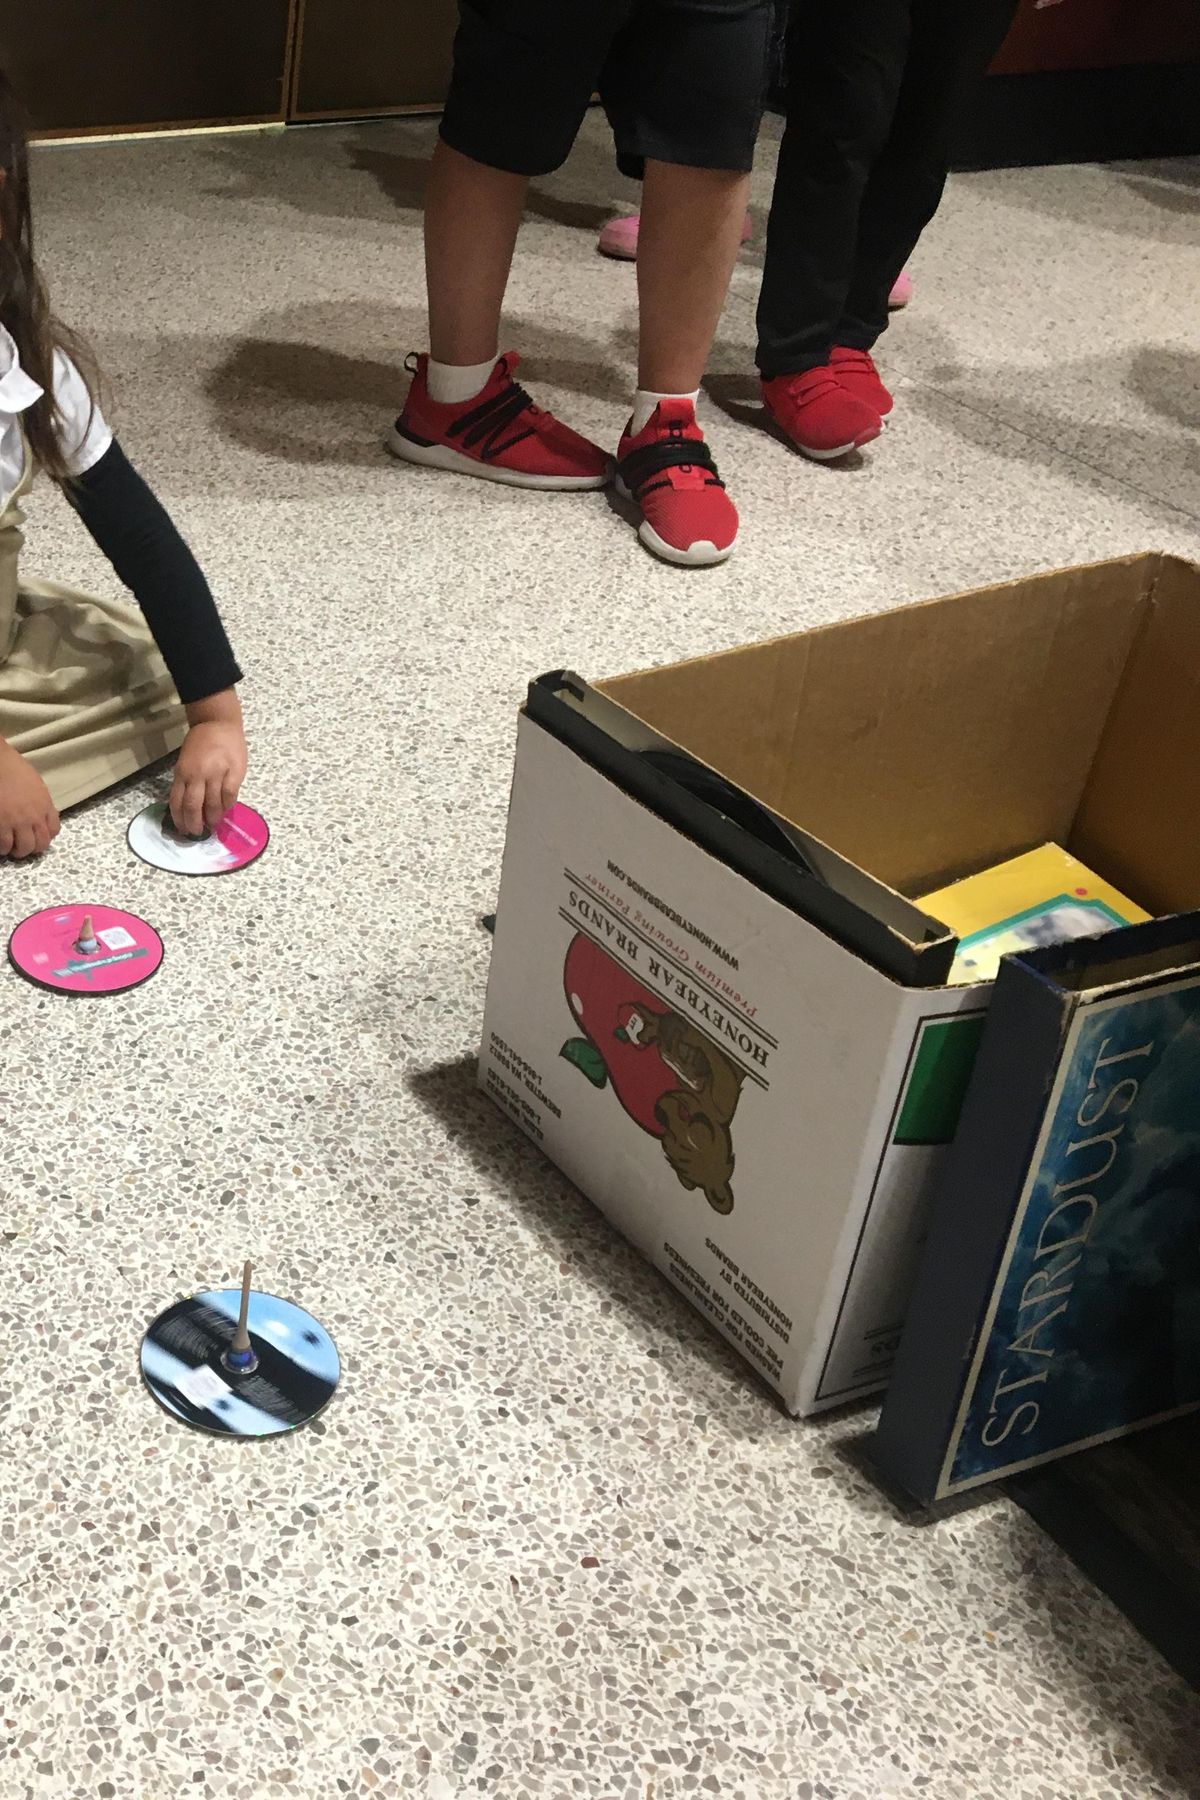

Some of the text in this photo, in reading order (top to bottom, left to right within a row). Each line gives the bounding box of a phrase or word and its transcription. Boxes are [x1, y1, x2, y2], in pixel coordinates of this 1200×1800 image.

[568, 890, 770, 1068] HONEYBEAR BRANDS
[584, 873, 758, 1018] Premium Growing Partner
[663, 1242, 711, 1294] FRESHNESS
[705, 1238, 793, 1331] HONEYBEAR BRANDS
[981, 1036, 1155, 1449] STARDUST
[711, 1289, 730, 1313] FOR
[719, 1268, 790, 1344] DISTRIBUTED BY
[731, 1309, 765, 1349] COOLED
